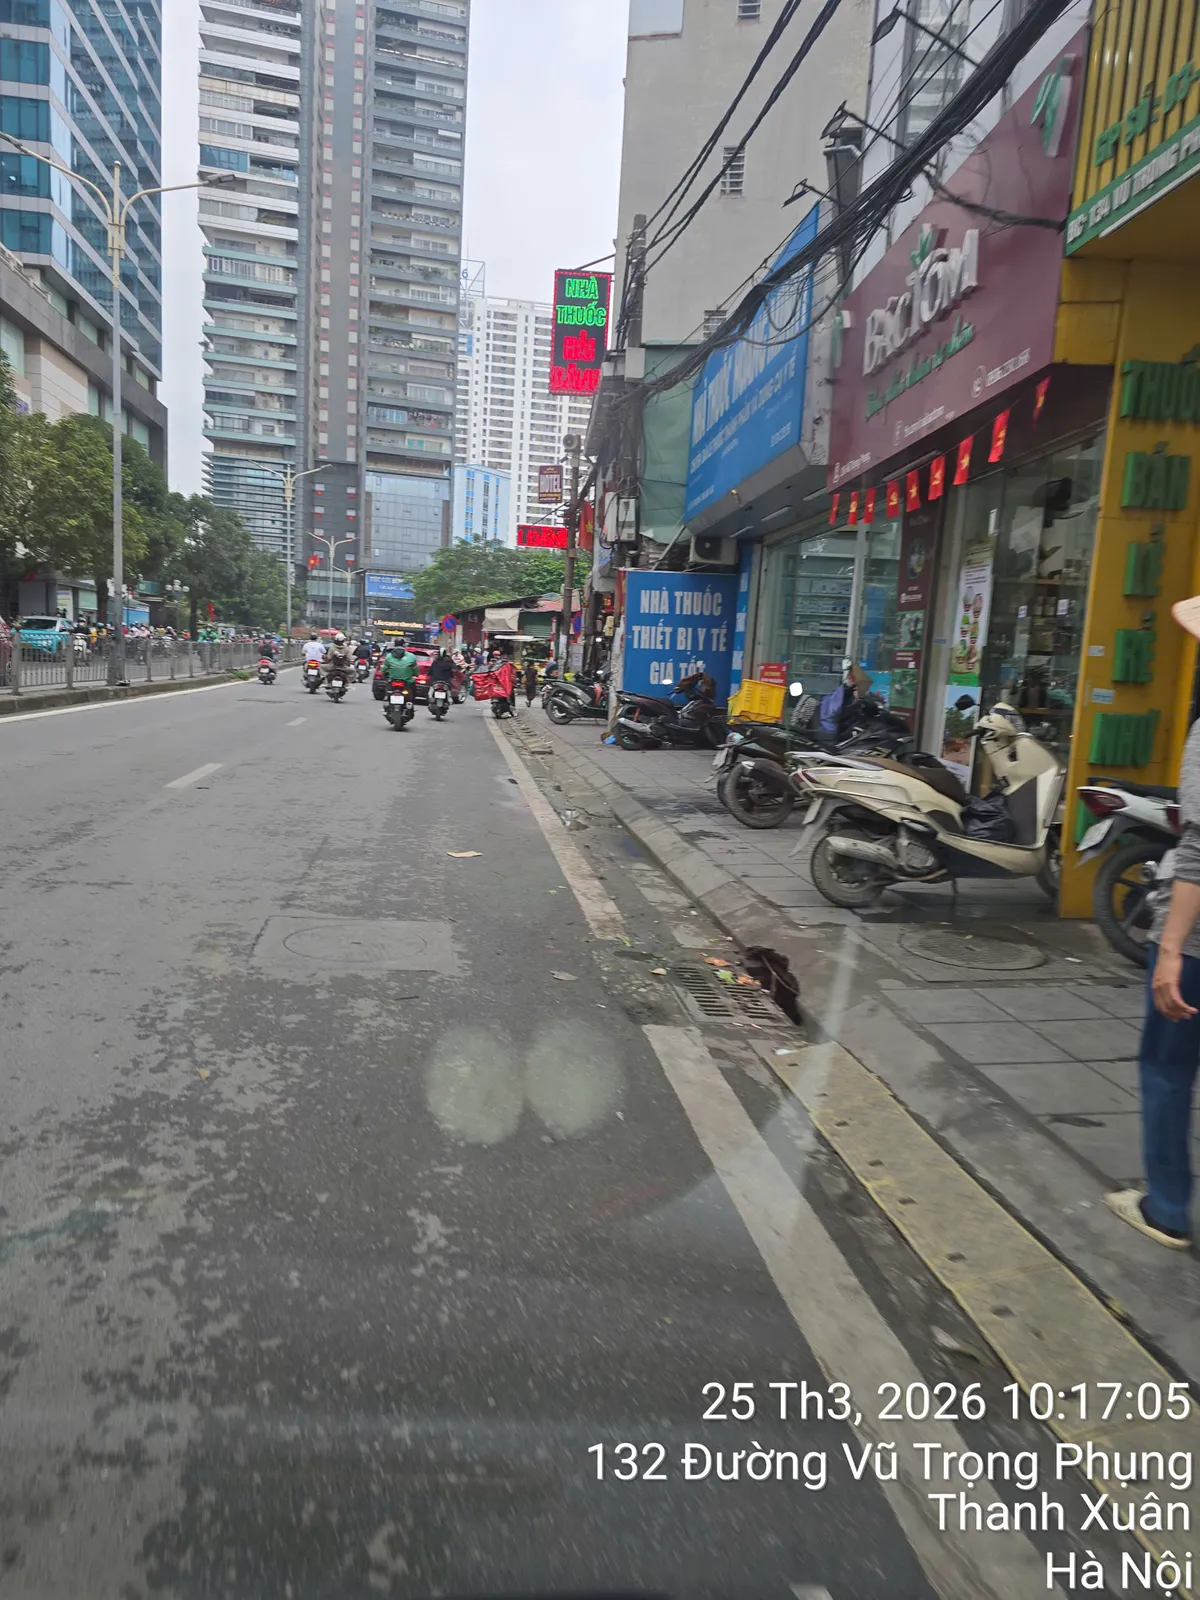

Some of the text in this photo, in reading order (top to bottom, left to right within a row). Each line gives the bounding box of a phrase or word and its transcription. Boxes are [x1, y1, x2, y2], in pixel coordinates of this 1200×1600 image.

[1112, 174, 1132, 211] VŨ
[565, 276, 599, 300] NHÀ
[556, 301, 606, 327] THUỐC
[539, 474, 562, 493] HOTEL
[1120, 441, 1191, 510] BÁN
[640, 584, 722, 616] NHÀ THUỐC
[632, 619, 727, 655] THIẾT BỊ Y TẾ
[1112, 611, 1157, 682] RẺ
[650, 659, 674, 684] GIÁ
